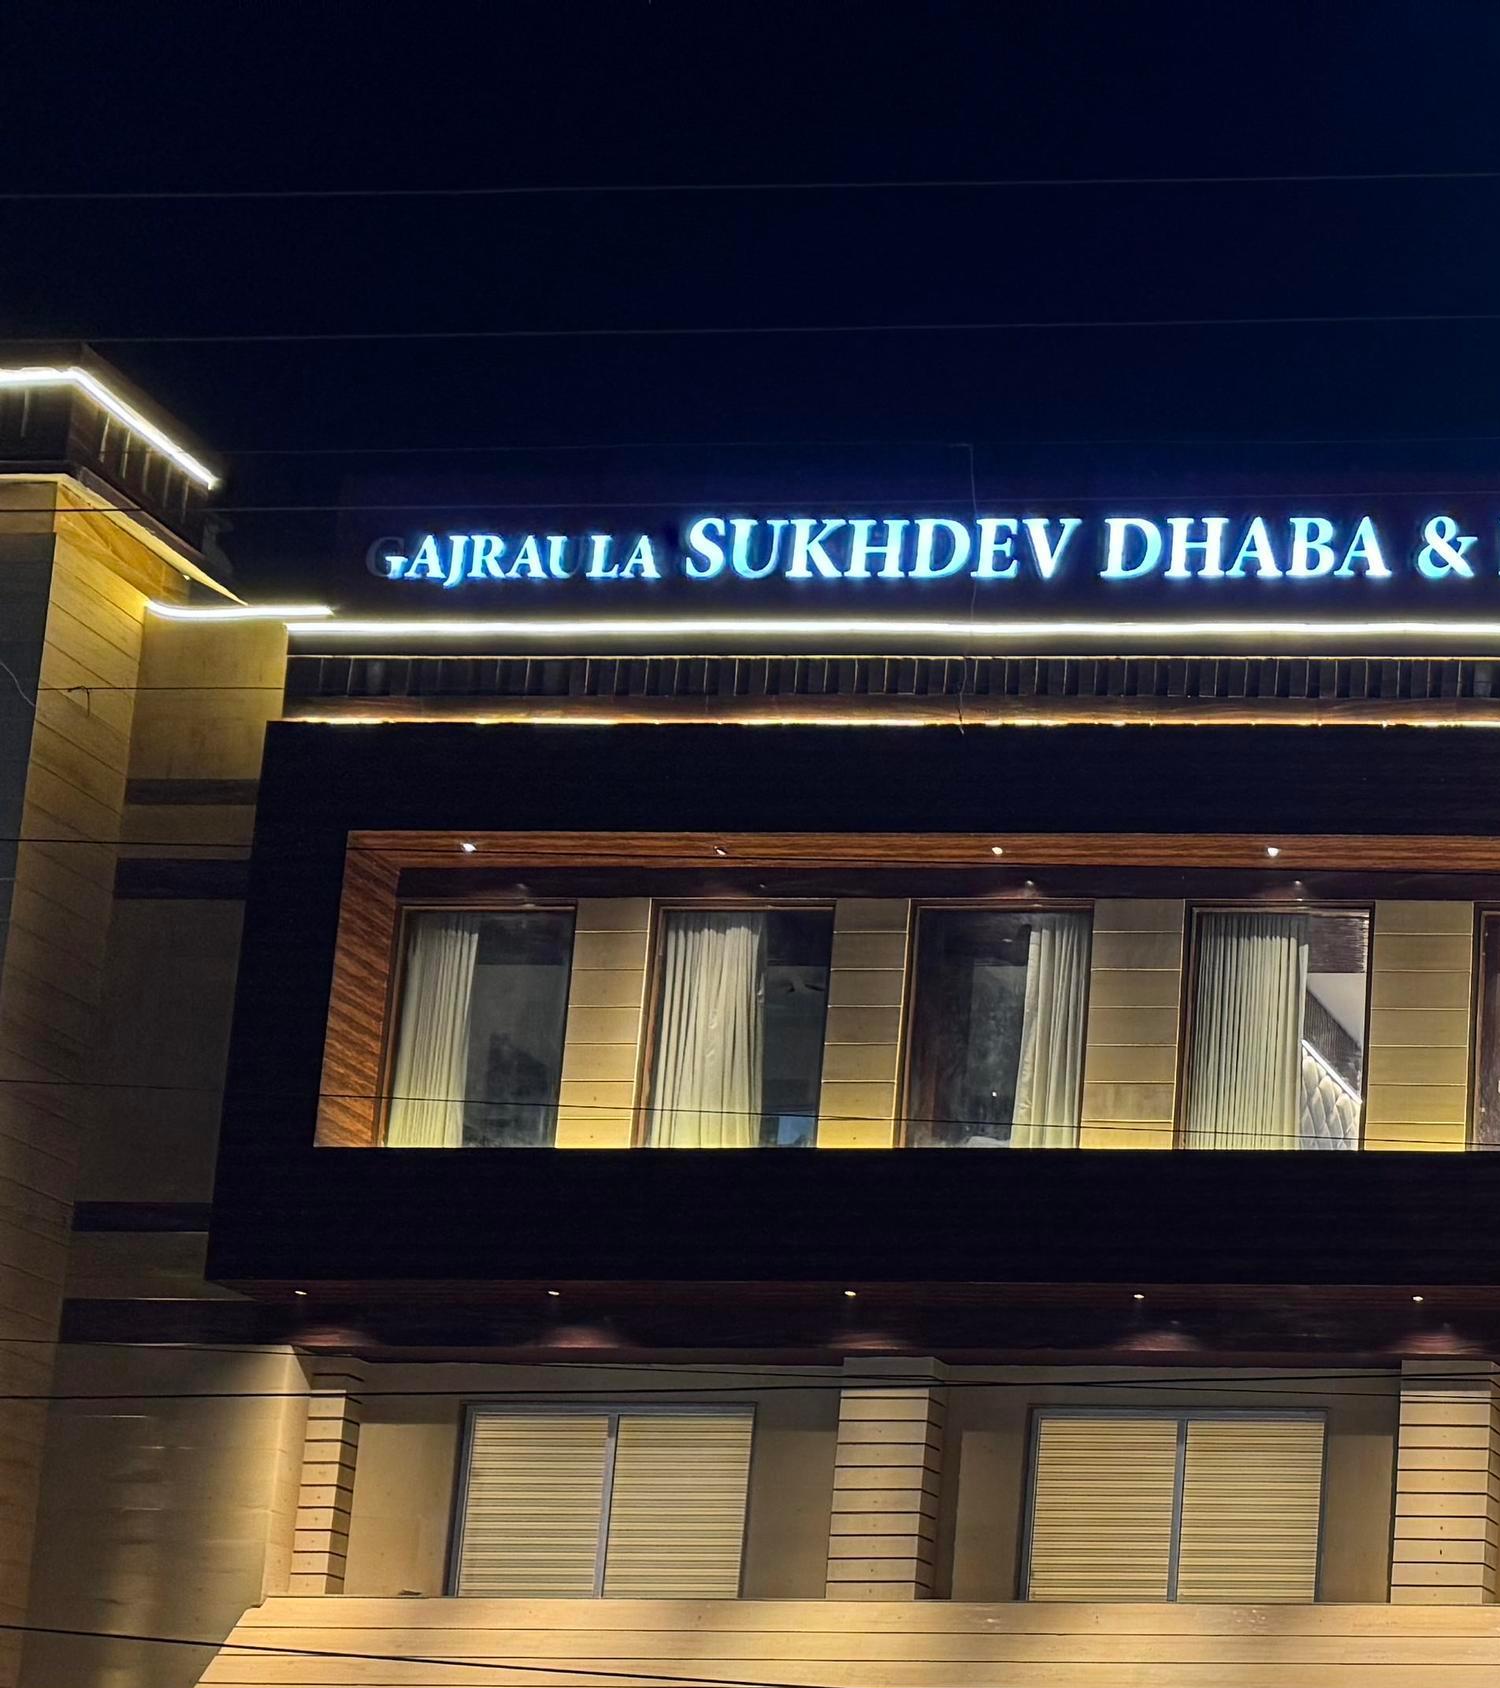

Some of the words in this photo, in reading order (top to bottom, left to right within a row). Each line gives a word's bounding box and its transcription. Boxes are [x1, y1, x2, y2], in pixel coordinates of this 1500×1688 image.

[366, 534, 662, 588] GAJRAULA
[685, 517, 1083, 581] SUKHDEV
[1100, 515, 1393, 581] DHABA
[1417, 515, 1478, 580] &
